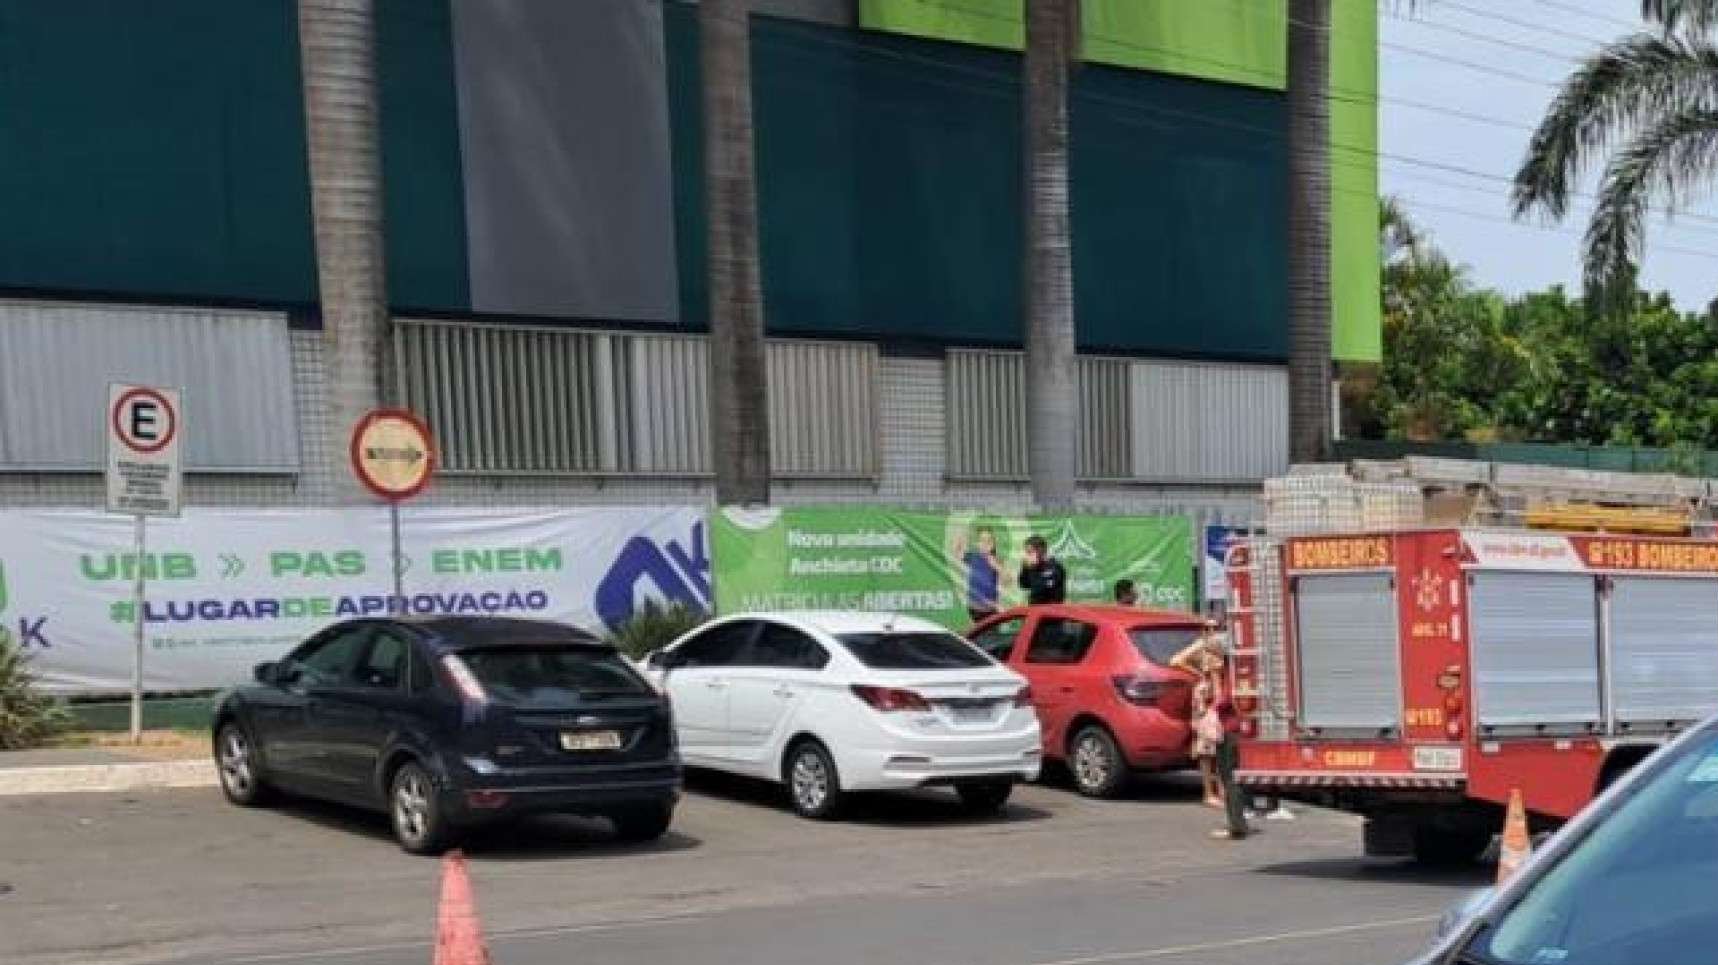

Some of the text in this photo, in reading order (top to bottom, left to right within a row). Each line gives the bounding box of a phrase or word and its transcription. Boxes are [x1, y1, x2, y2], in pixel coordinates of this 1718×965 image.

[132, 402, 156, 440] E
[789, 527, 905, 547] Nova unidade
[79, 548, 562, 581] UNB PAS ENEM
[791, 557, 868, 574] Anchieta
[1293, 538, 1387, 568] BOMBEIROS
[1606, 540, 1634, 567] 193
